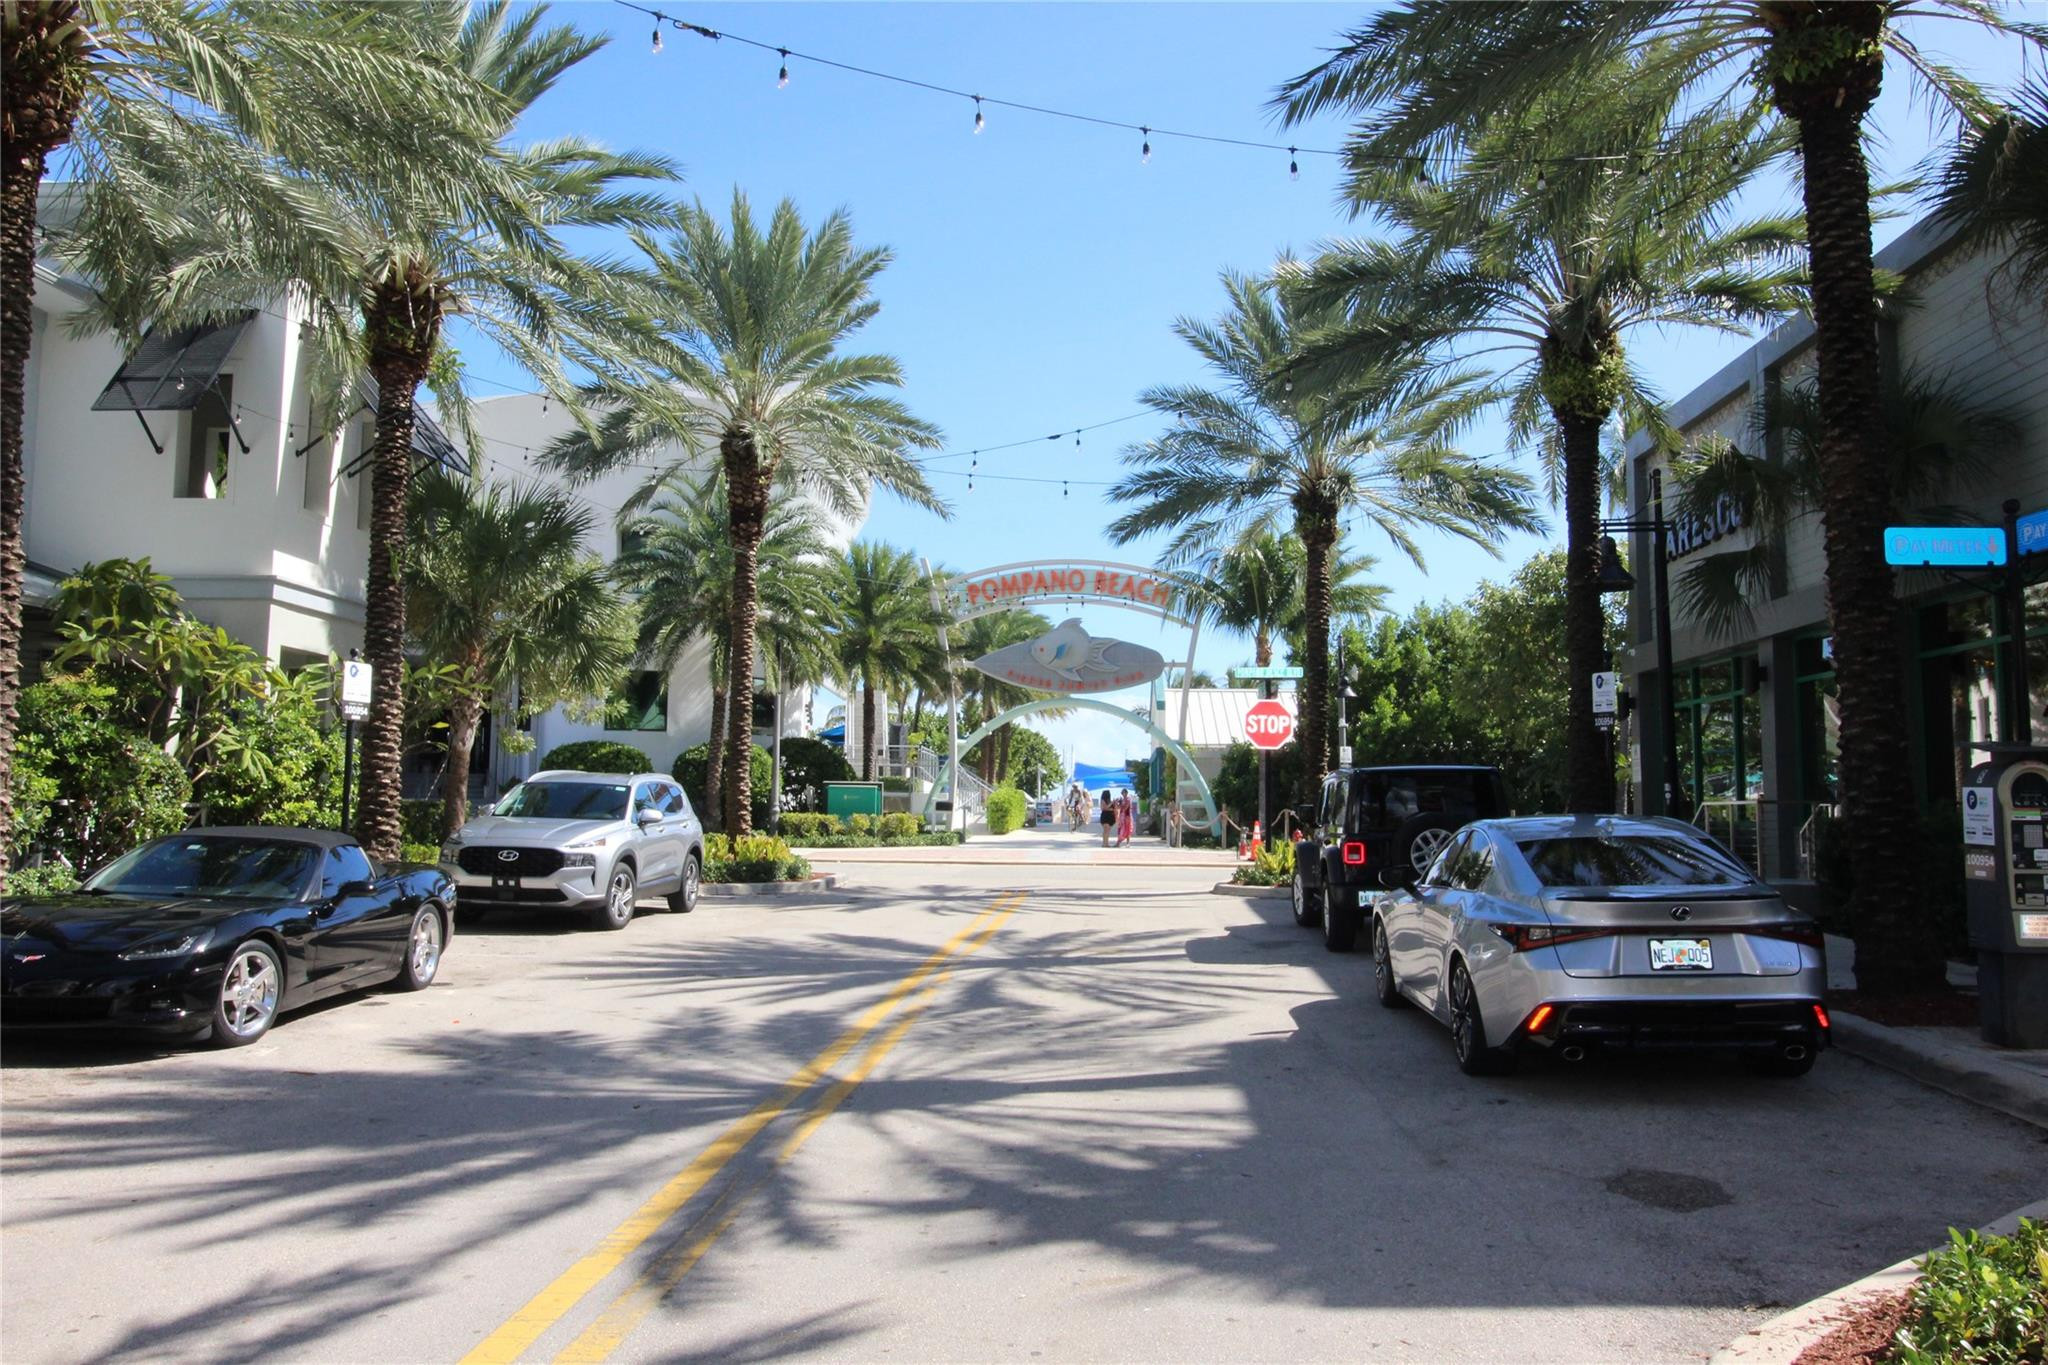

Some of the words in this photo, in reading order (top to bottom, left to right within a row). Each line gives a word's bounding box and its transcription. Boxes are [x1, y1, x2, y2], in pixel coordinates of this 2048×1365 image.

[967, 569, 1086, 606] POMPANO
[1094, 570, 1172, 606] BEACH
[1247, 714, 1290, 735] STOP
